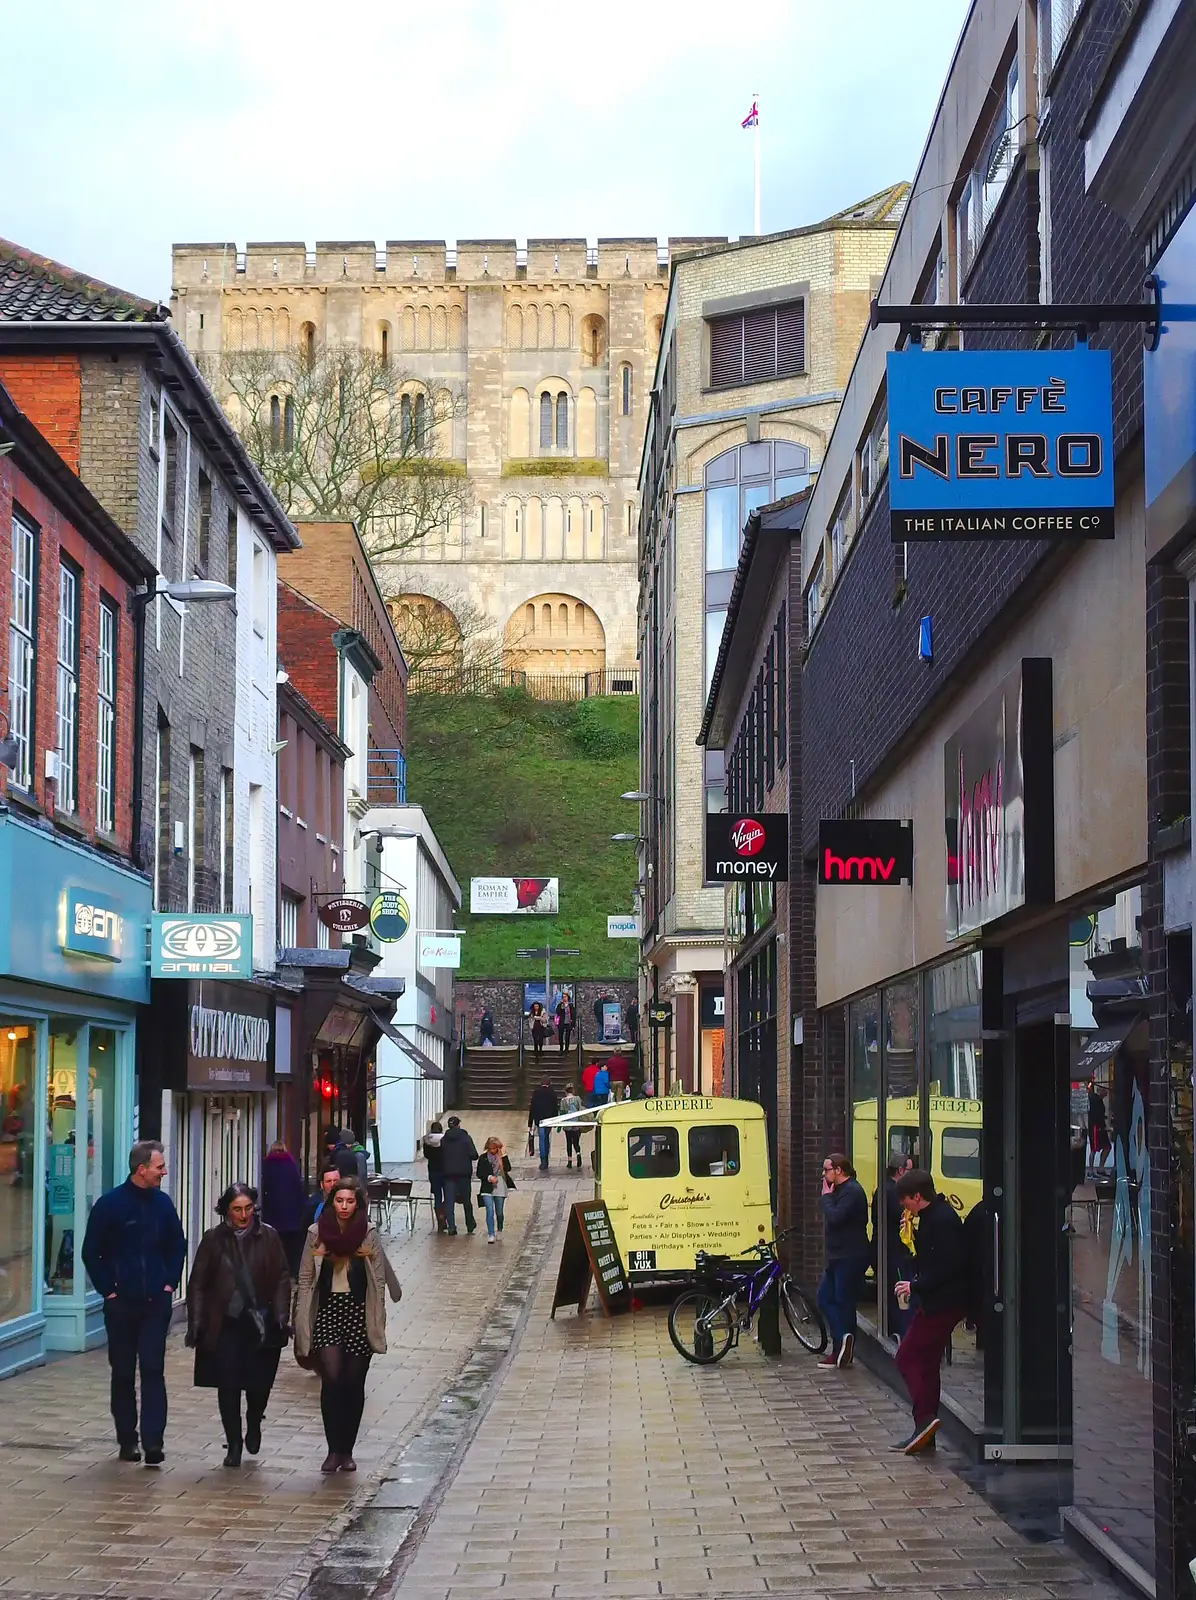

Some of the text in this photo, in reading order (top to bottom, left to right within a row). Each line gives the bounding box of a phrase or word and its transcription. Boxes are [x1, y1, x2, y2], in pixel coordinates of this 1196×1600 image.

[934, 376, 1067, 413] CAFFÈ
[900, 432, 1104, 481] NERO
[905, 518, 935, 531] THE
[941, 517, 1006, 531] ITALIAN
[1012, 516, 1073, 530] COFFEE
[732, 822, 763, 851] Virgin
[716, 861, 778, 878] money
[824, 848, 896, 881] hmv
[327, 900, 364, 910] PATISSERIE
[332, 923, 359, 931] VALERIE
[609, 922, 636, 931] maplin
[644, 1098, 714, 1111] CREPERIE
[660, 1192, 710, 1210] Christophe's
[634, 1260, 651, 1269] YUX
